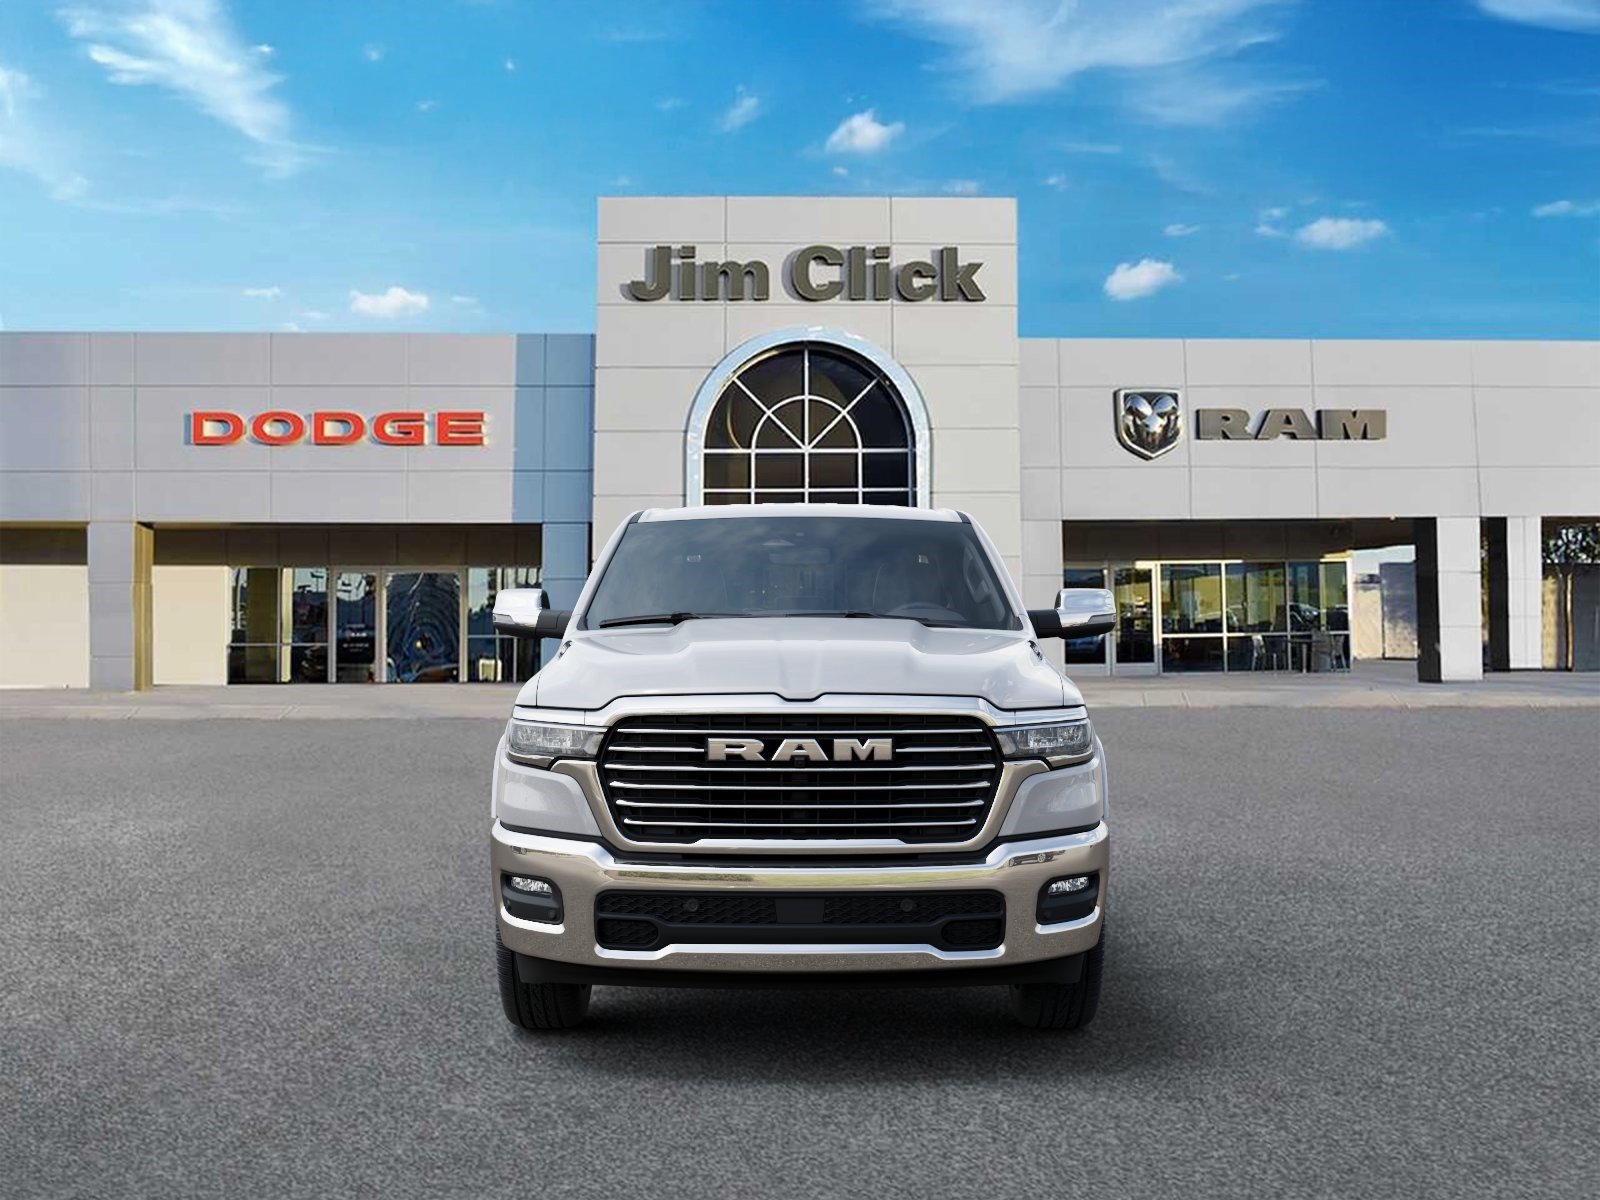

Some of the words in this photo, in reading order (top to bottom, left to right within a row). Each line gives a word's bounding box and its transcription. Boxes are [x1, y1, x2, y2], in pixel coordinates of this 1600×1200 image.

[628, 245, 770, 301] Jim
[790, 244, 986, 302] Click
[190, 410, 487, 446] DODGE
[1196, 408, 1387, 440] RAM
[707, 738, 893, 761] RAM
